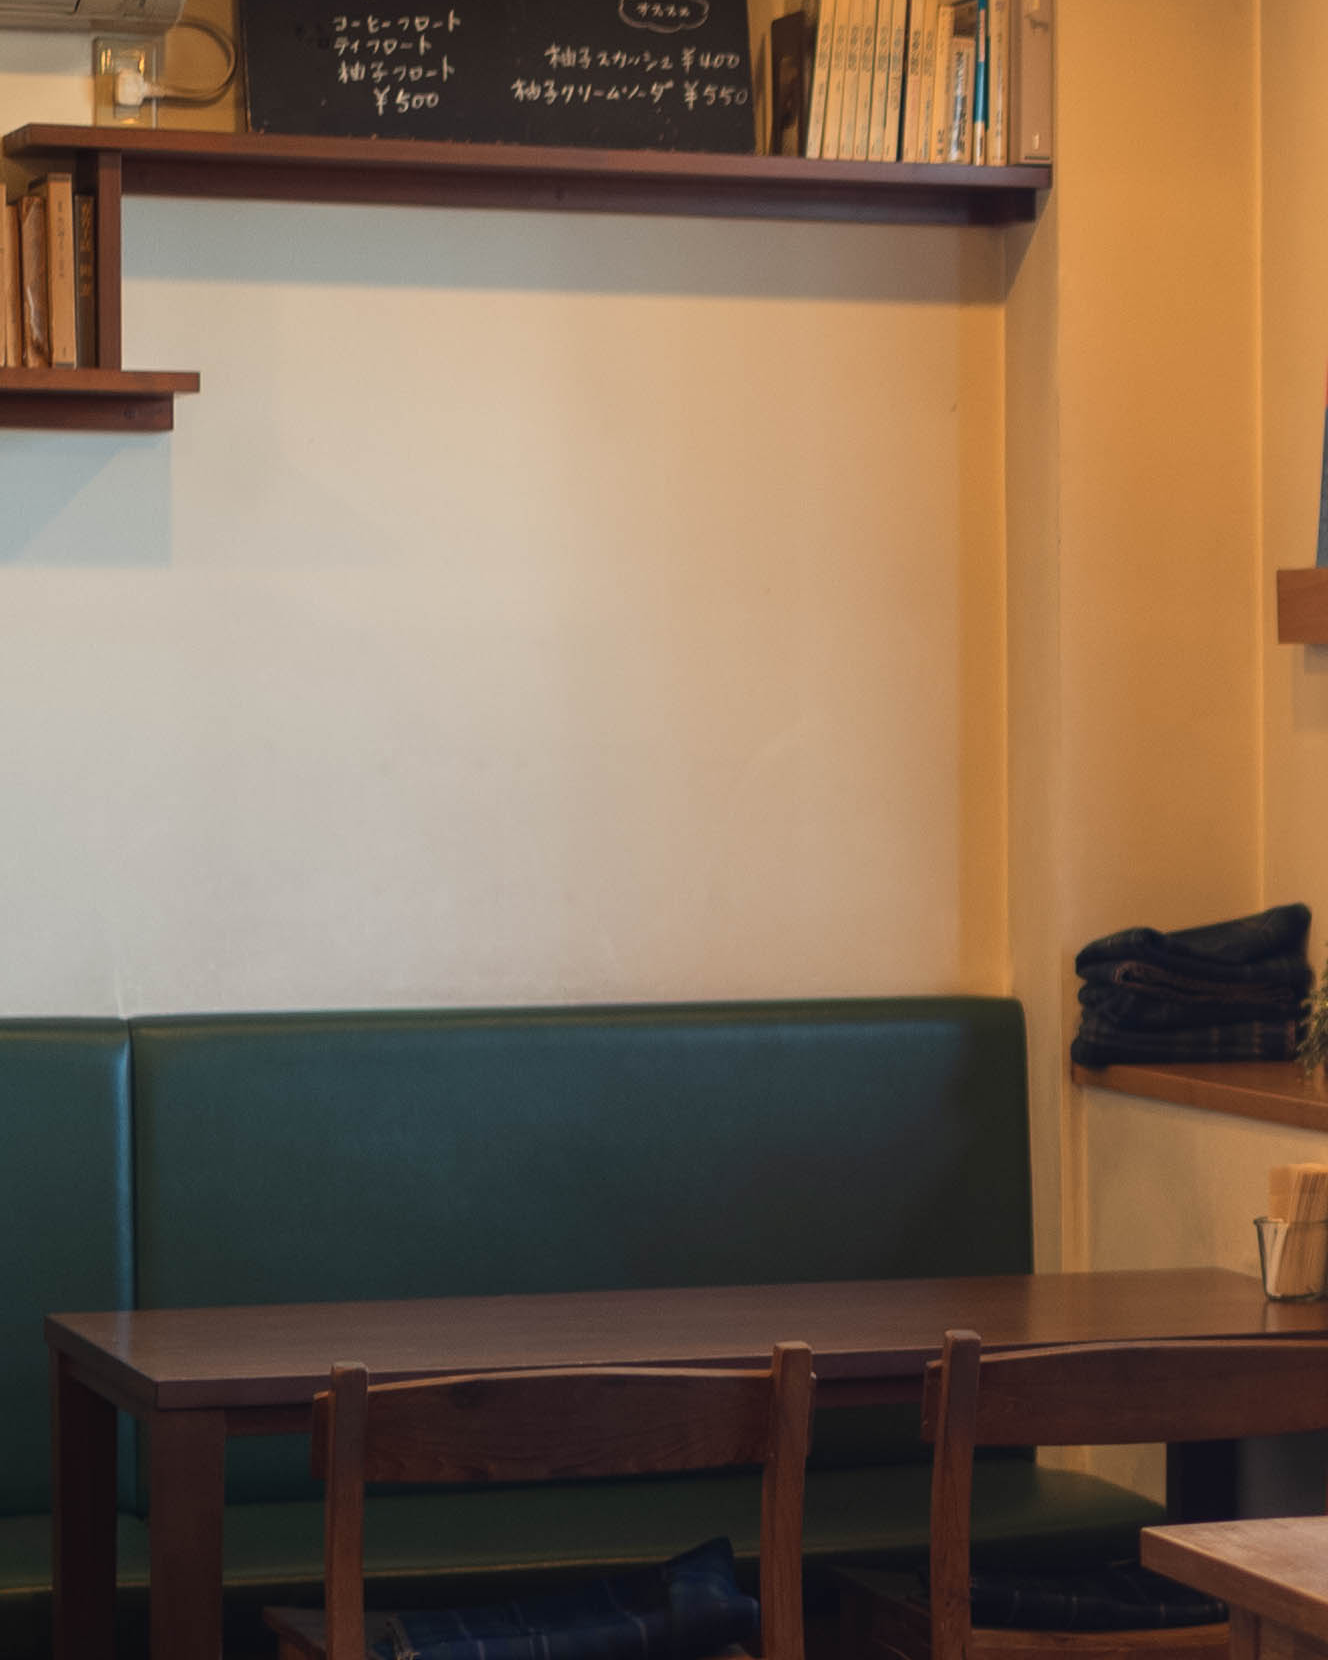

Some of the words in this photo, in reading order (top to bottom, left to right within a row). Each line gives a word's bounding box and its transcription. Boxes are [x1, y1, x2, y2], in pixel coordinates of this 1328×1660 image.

[333, 9, 461, 33] コーヒーフロート
[338, 55, 455, 84] 柚子フロート
[681, 46, 741, 75] ¥400
[373, 84, 440, 116] ¥500
[683, 80, 749, 110] ¥550
